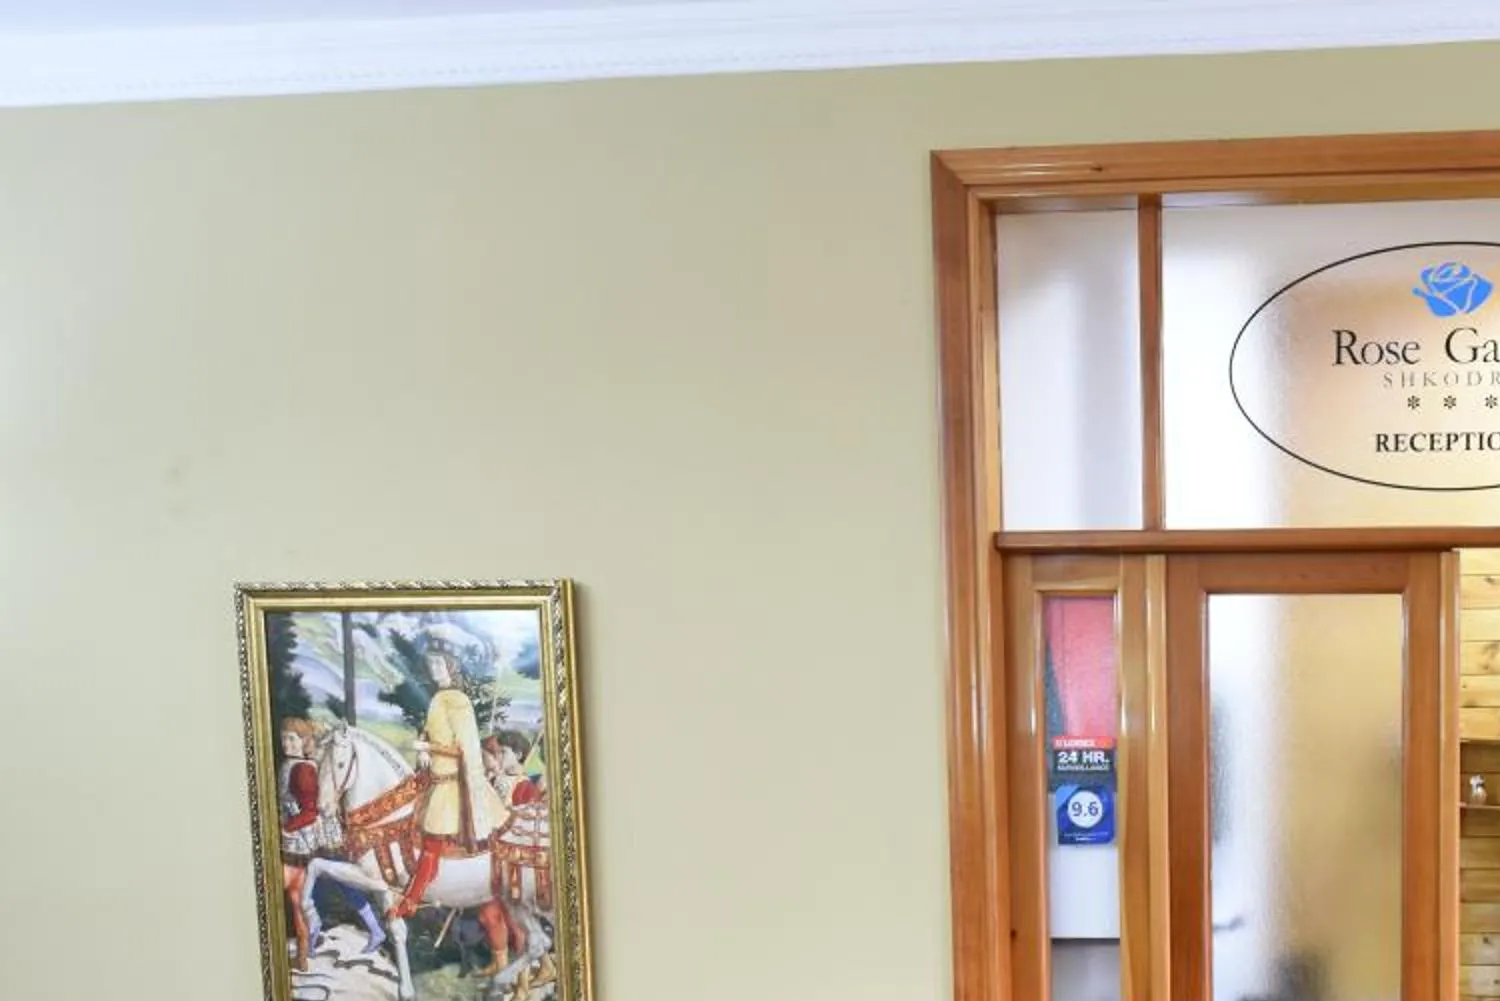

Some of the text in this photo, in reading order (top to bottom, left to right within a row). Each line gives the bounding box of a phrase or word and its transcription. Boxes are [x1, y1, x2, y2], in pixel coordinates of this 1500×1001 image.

[1332, 328, 1421, 366] Rose
[1057, 750, 1078, 763] 24
[1071, 801, 1099, 817] 9.6
